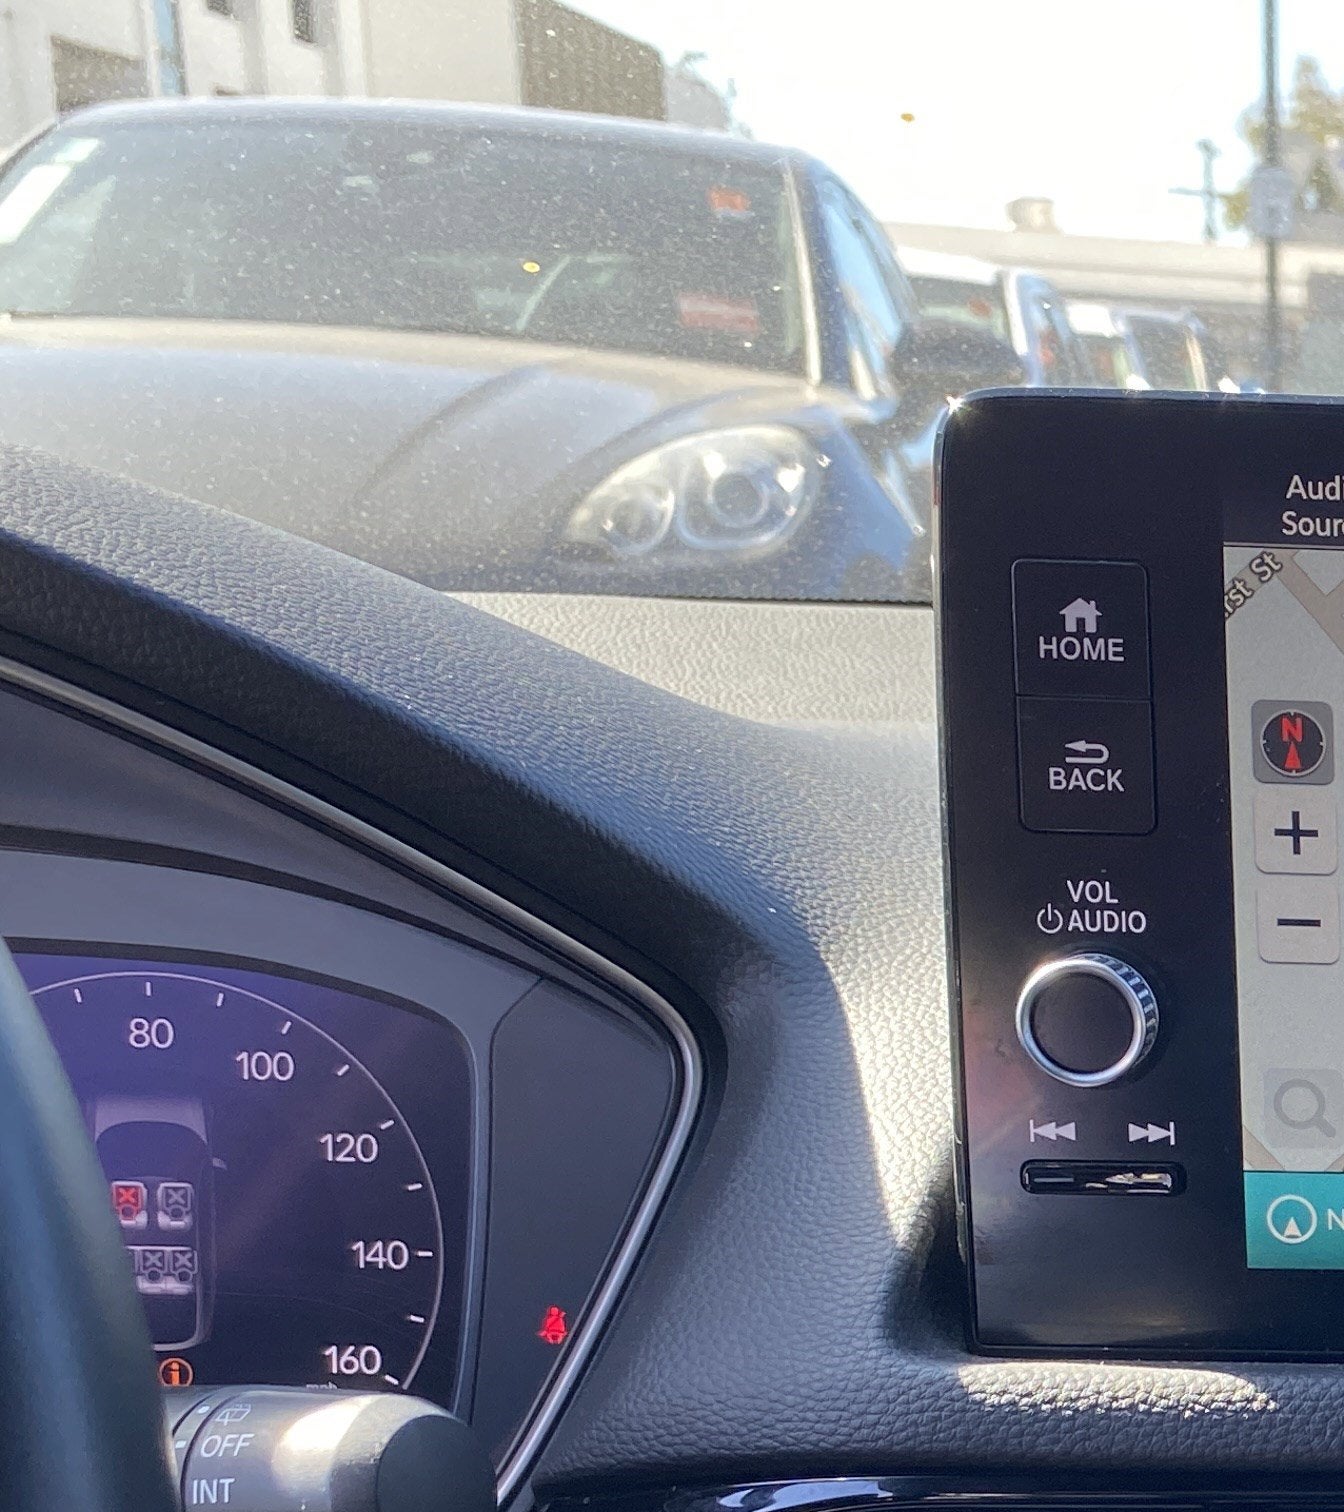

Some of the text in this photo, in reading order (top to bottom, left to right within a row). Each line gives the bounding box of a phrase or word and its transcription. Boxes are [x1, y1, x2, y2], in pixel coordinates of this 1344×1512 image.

[1251, 552, 1282, 581] St
[1038, 635, 1125, 662] HOME
[1048, 766, 1125, 792] BACK
[1066, 879, 1119, 904] VOL
[1067, 909, 1147, 934] AUDIO
[128, 1018, 174, 1049] 80
[235, 1051, 295, 1081] 100
[319, 1133, 378, 1163] 120
[351, 1240, 409, 1270] 140
[323, 1345, 382, 1375] 160
[200, 1434, 254, 1458] OFF
[193, 1479, 235, 1504] INT
